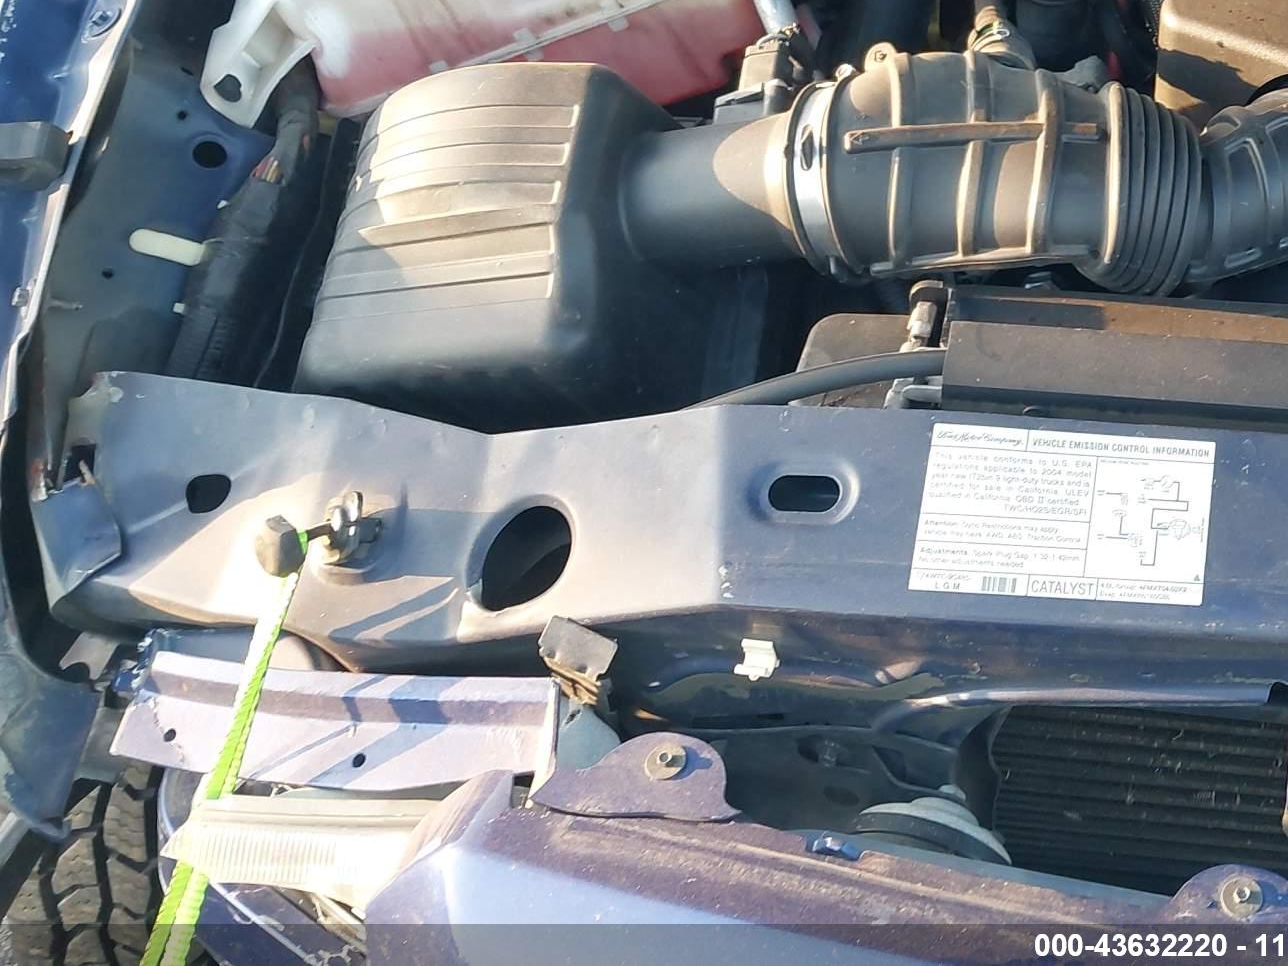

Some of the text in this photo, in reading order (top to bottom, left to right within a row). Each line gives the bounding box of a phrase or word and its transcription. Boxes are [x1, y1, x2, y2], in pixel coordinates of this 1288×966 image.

[1032, 437, 1209, 457] VEHICLE EMISSION CONTROL INFORMATION
[992, 455, 1033, 464] conforms
[1075, 460, 1092, 468] EPA
[983, 464, 1091, 479] applicable to 2004 model
[1016, 485, 1058, 495] California
[1014, 494, 1034, 503] OBD
[1047, 496, 1079, 506] certified
[1030, 579, 1093, 596] CATALYST
